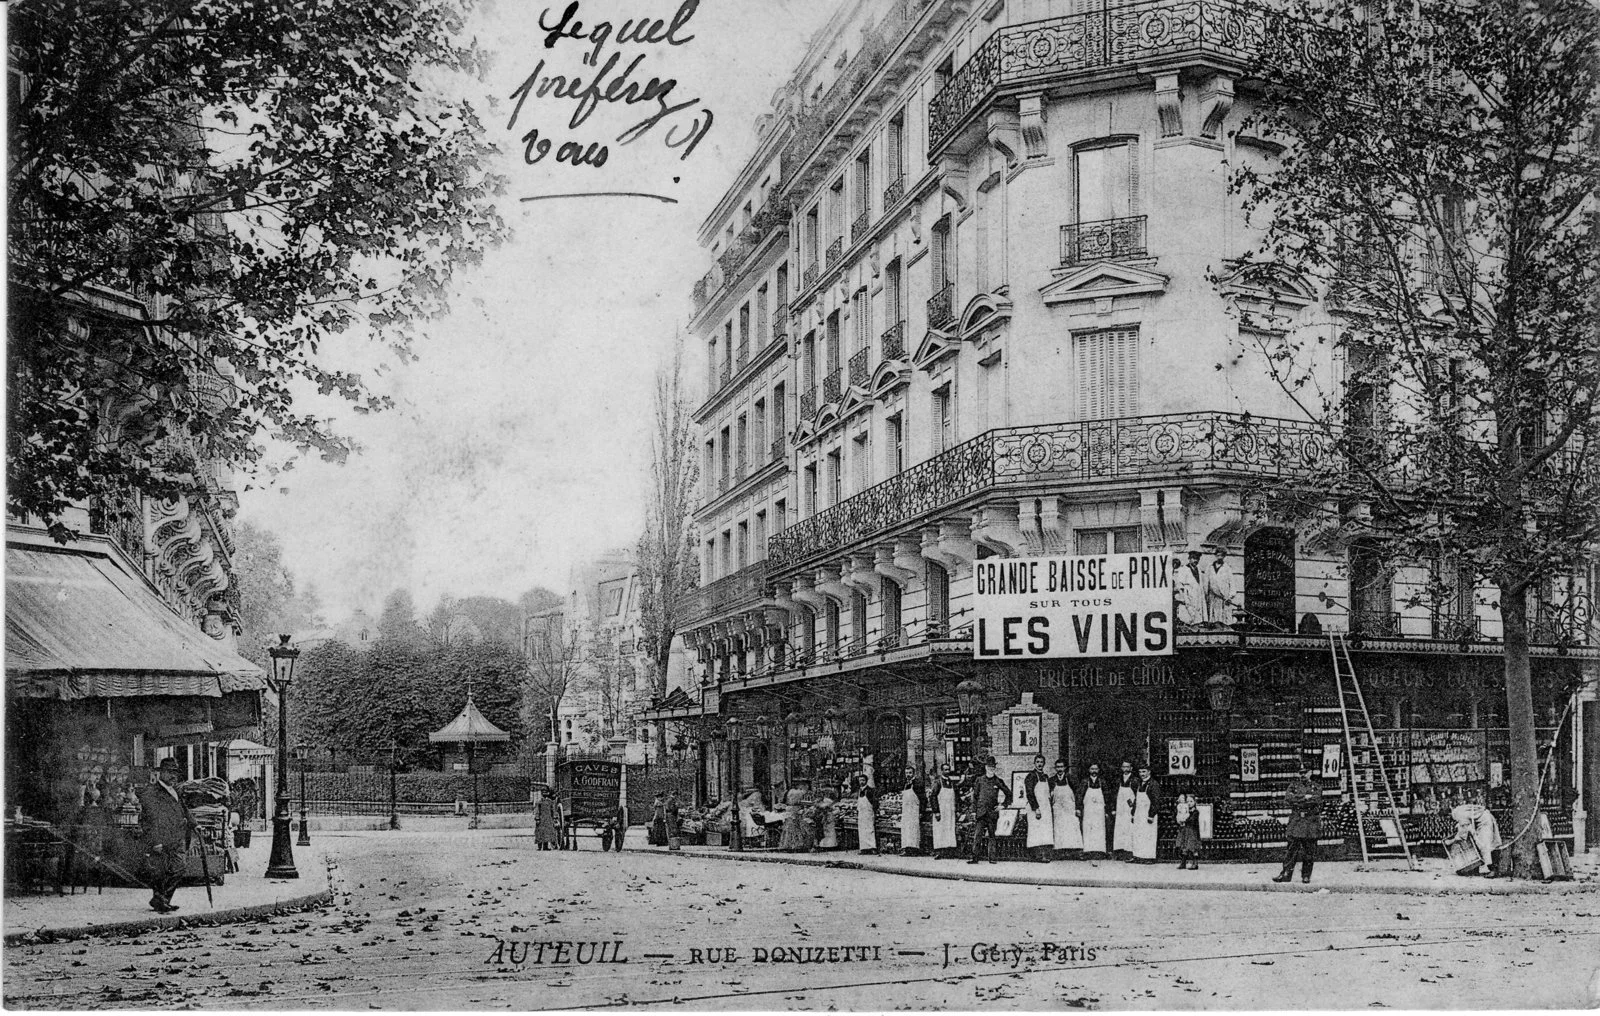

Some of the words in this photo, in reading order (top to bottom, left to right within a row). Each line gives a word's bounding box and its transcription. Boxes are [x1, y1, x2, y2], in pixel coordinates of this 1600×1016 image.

[538, 0, 700, 66] Lequel
[976, 561, 1039, 595] GRANDE
[1048, 557, 1108, 593] BAISSE
[1111, 571, 1125, 590] DE
[1128, 554, 1169, 589] PRIX
[1029, 600, 1062, 609] SUR
[1070, 598, 1113, 608] TOUS
[978, 616, 1051, 657] LES
[1071, 610, 1168, 654] VINS
[1108, 671, 1126, 687] DE
[1131, 665, 1176, 686] CHOIX
[575, 764, 618, 774] CAVES
[1171, 755, 1192, 770] 20
[1243, 760, 1256, 775] 55
[1324, 758, 1338, 773] 40
